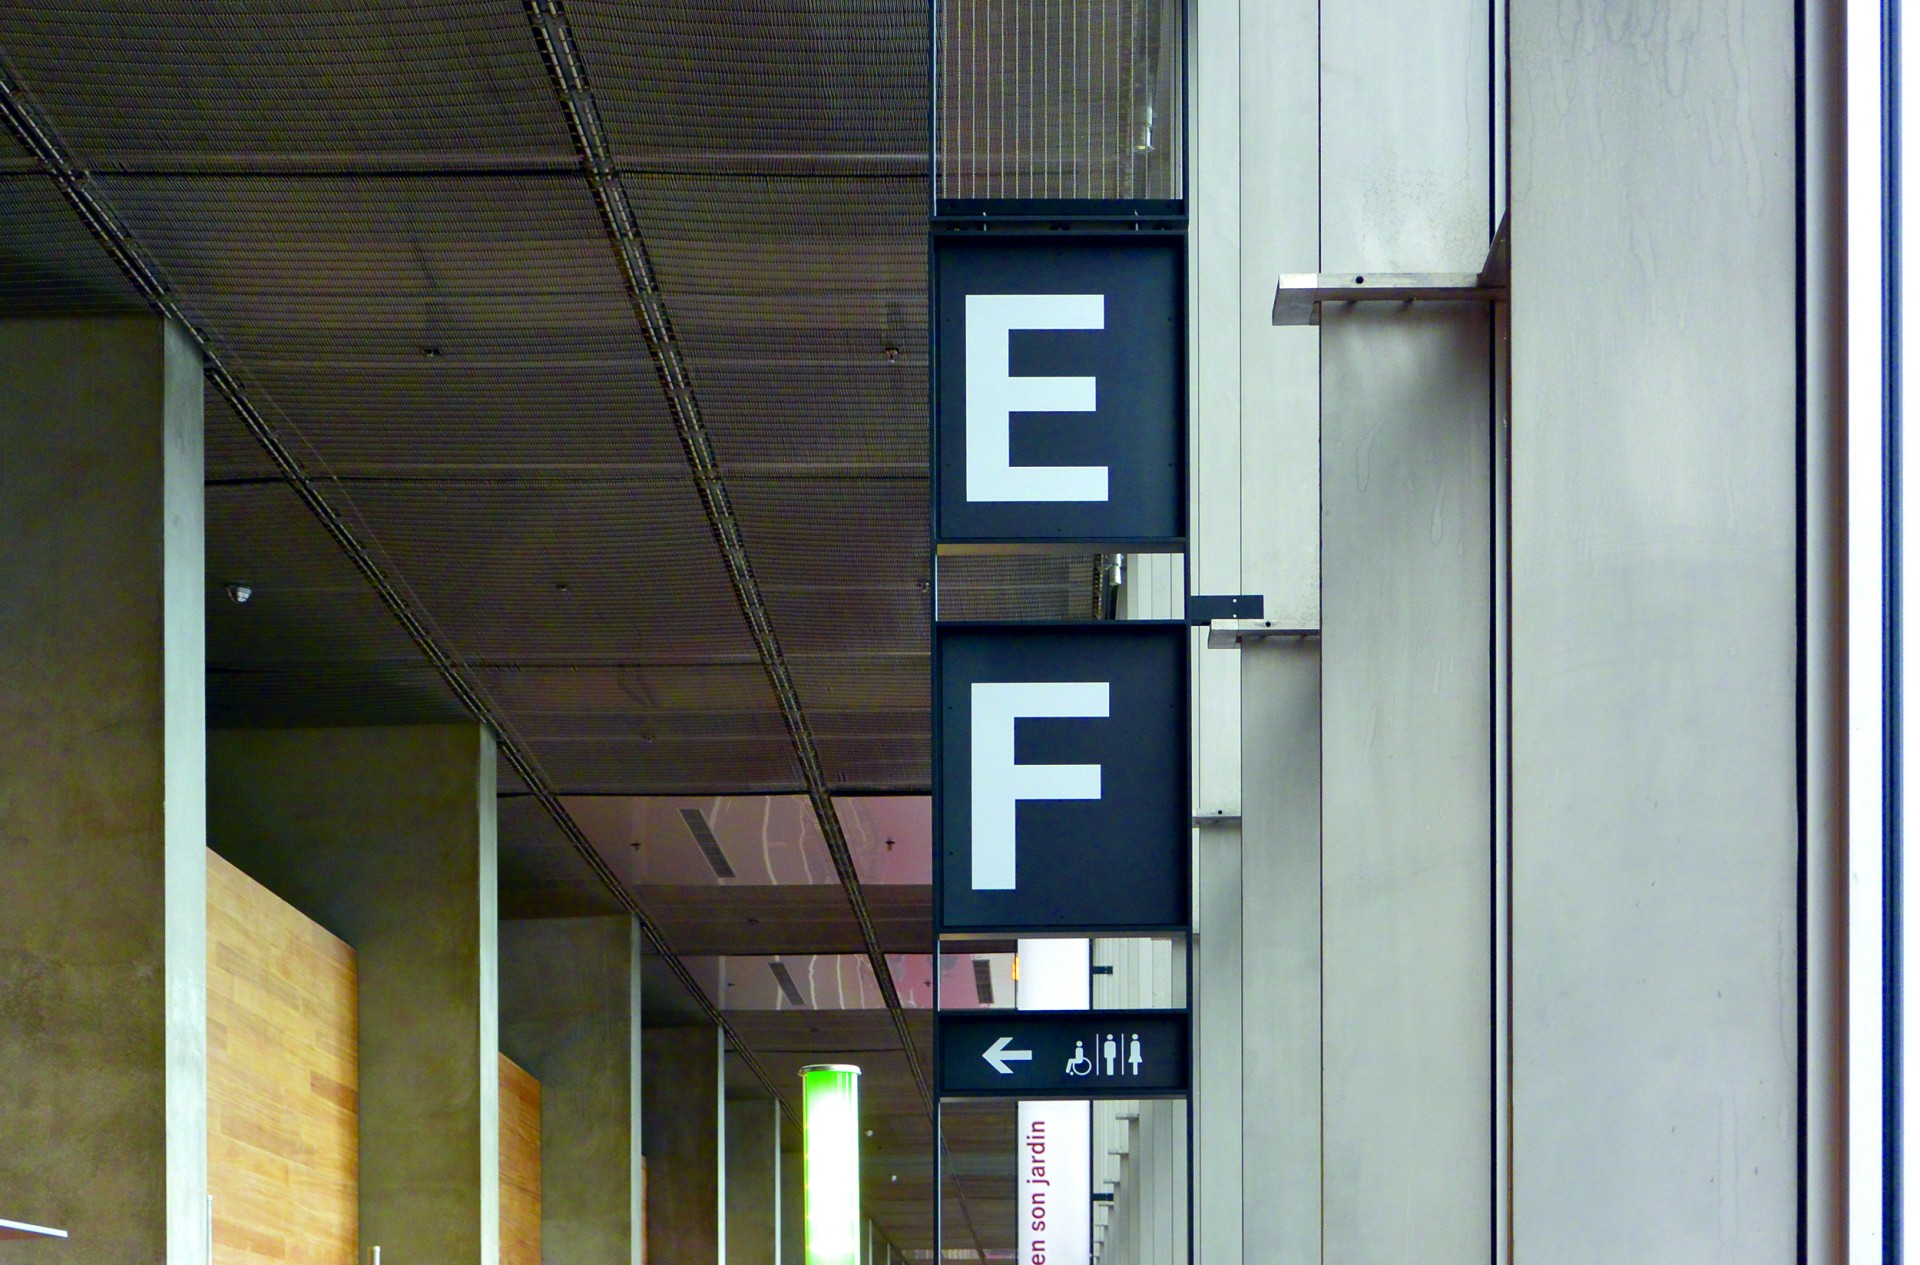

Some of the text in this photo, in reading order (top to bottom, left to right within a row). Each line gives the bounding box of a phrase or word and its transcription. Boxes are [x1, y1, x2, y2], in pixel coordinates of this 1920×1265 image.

[965, 294, 1109, 502] E
[971, 682, 1110, 890] F
[1026, 1121, 1050, 1265] en son jardin
